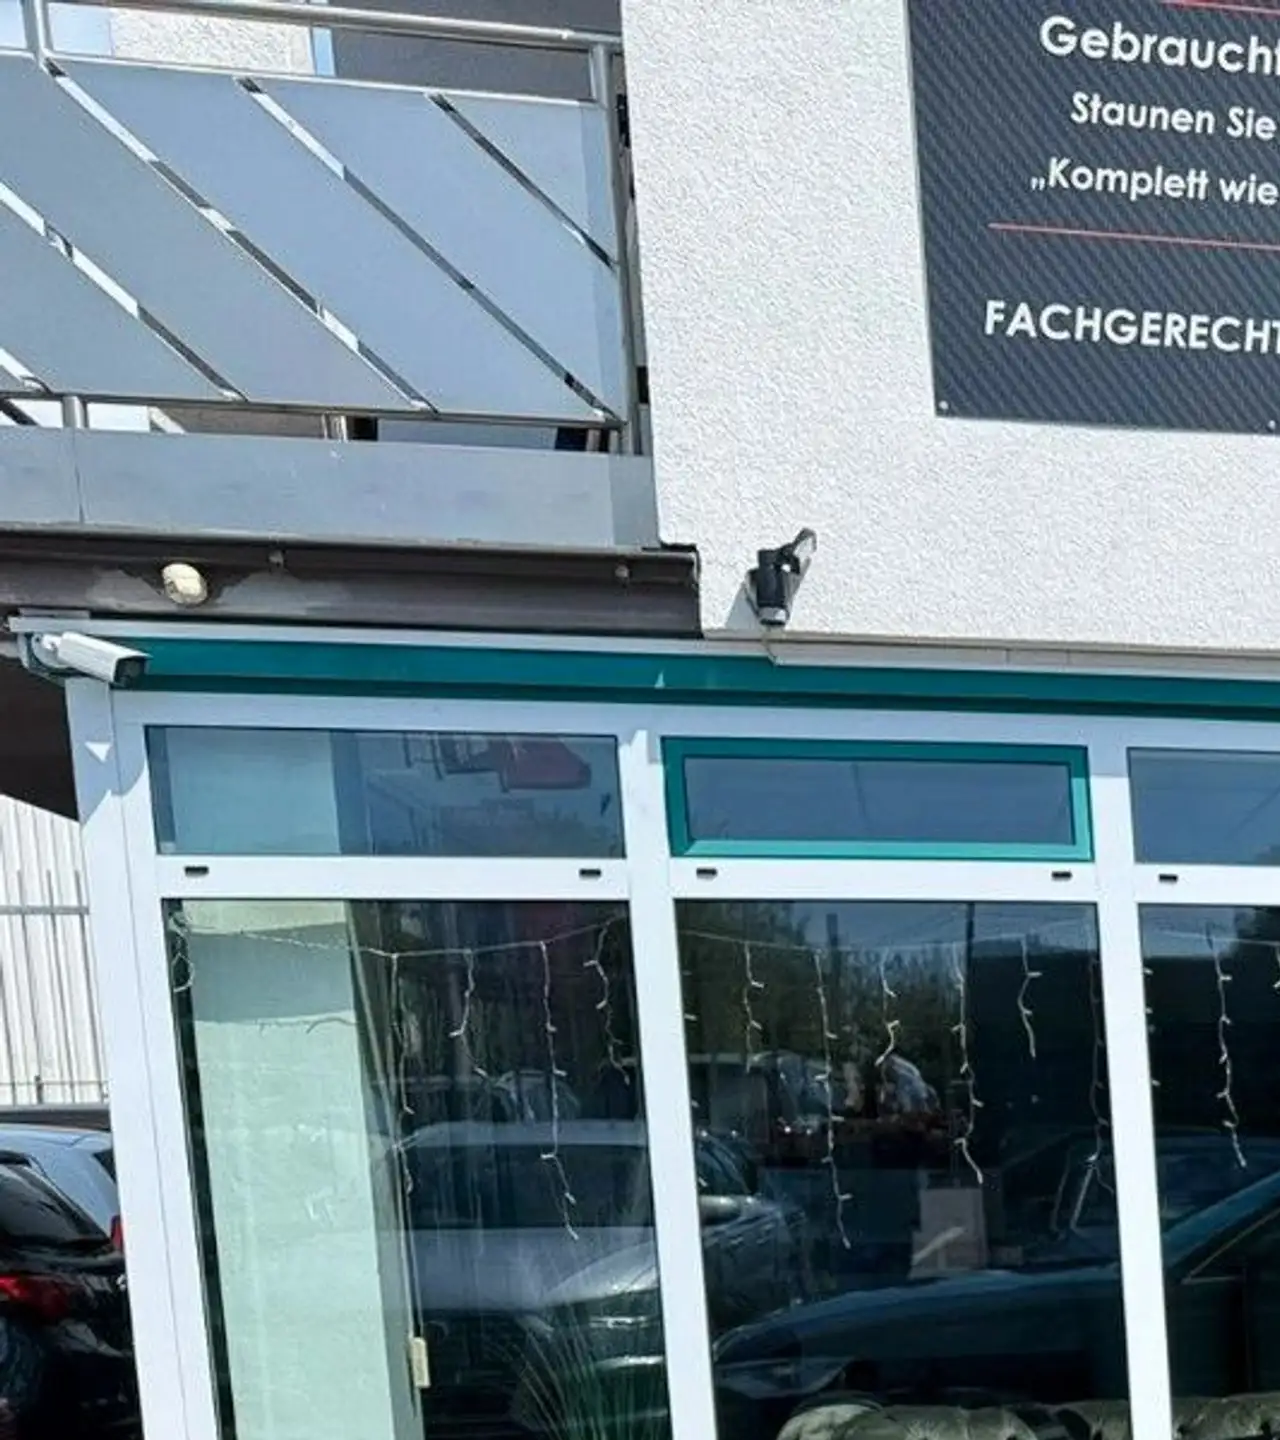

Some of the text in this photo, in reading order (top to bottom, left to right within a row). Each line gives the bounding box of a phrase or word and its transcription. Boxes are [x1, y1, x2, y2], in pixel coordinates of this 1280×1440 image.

[1070, 91, 1217, 135] Staunen
[1226, 106, 1278, 140] Sie
[1031, 157, 1210, 201] „Komplett
[1219, 173, 1280, 206] wie
